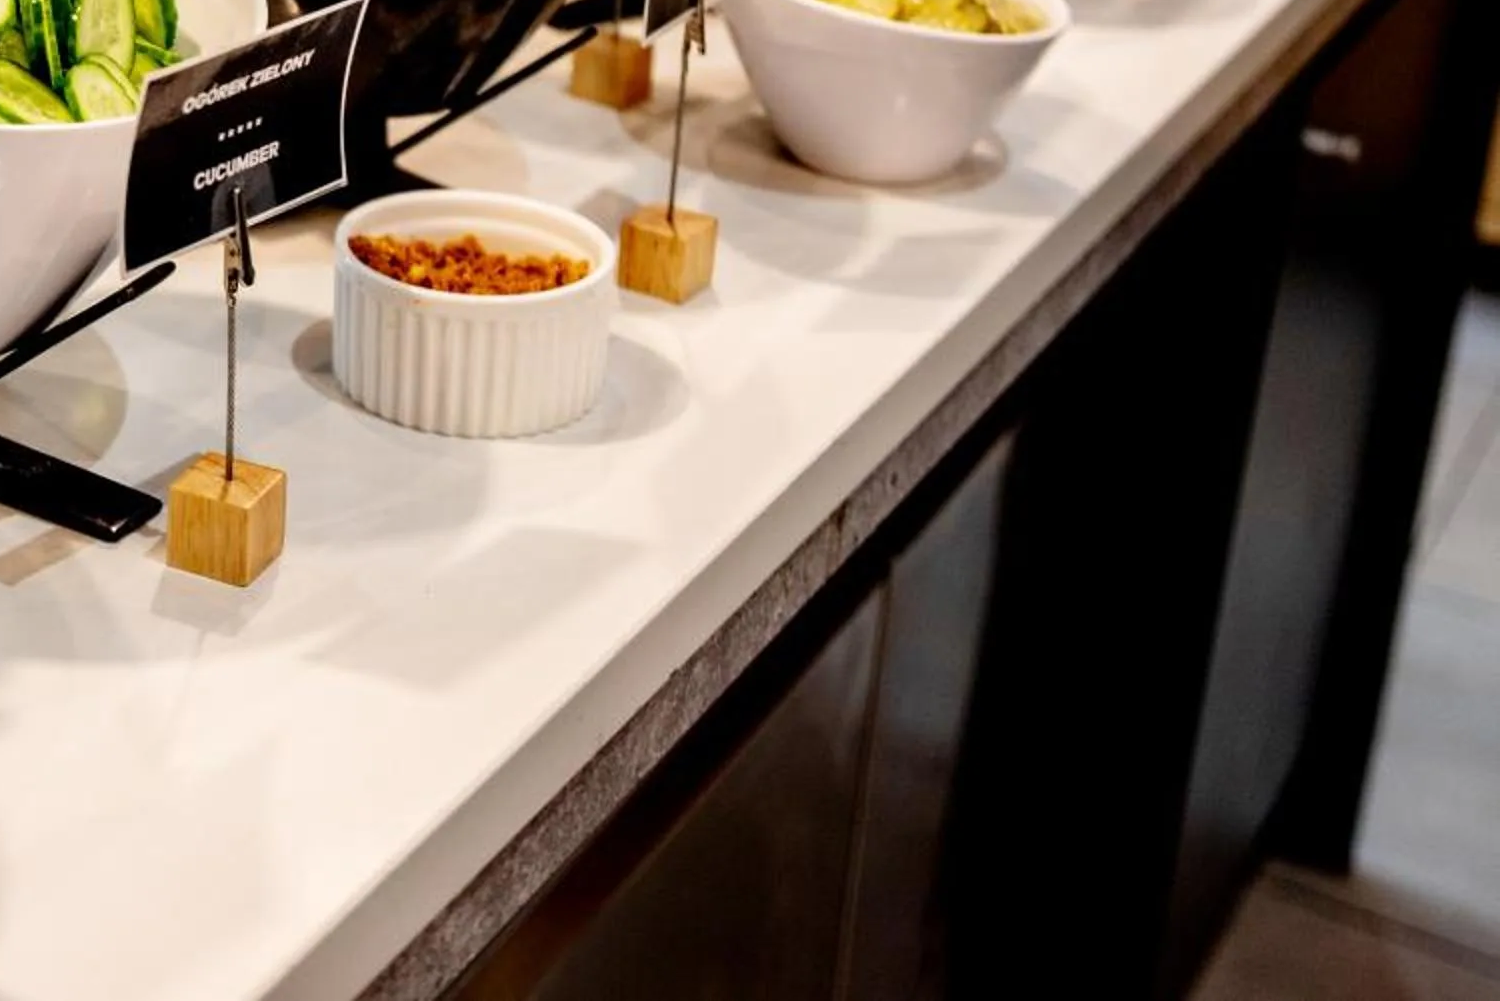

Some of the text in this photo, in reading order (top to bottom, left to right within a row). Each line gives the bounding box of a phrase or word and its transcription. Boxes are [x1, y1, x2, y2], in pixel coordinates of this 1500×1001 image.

[182, 49, 315, 114] OGÓREK ZIELONY
[193, 141, 280, 190] CUCUMBER
